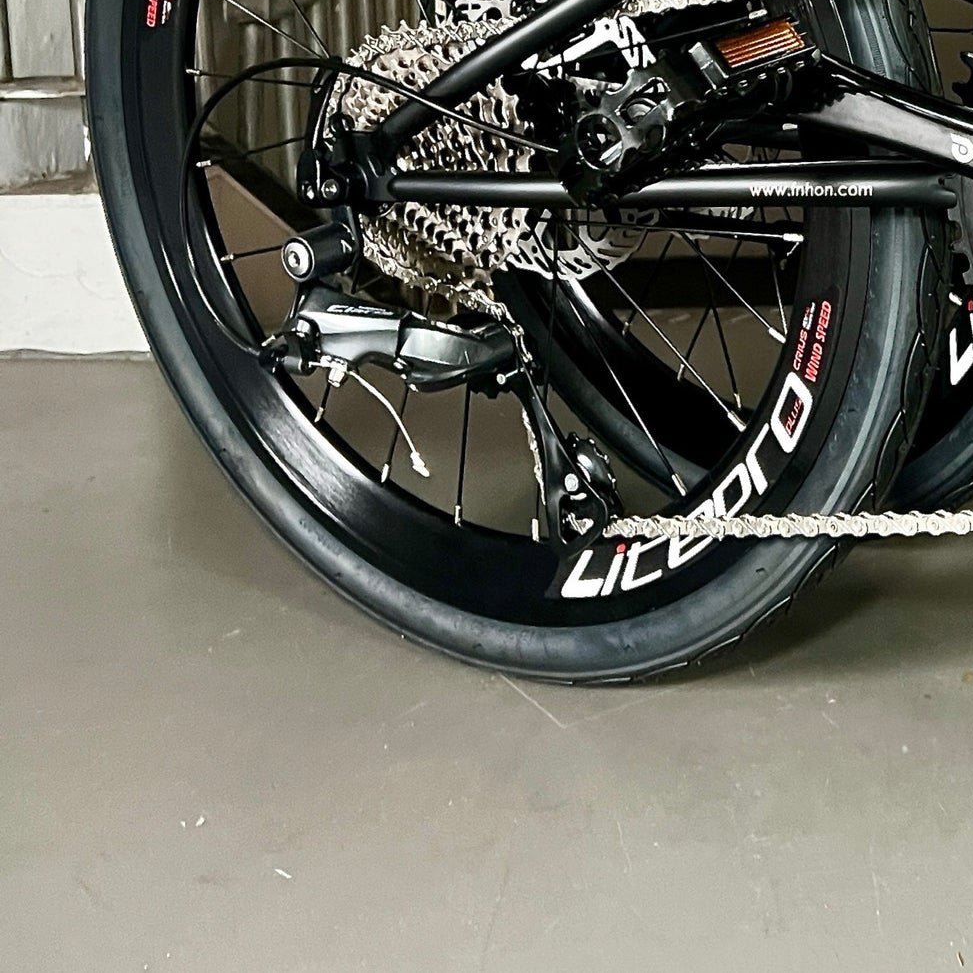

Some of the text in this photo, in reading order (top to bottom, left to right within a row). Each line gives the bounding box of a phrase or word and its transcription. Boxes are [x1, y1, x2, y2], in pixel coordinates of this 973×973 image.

[749, 181, 873, 197] www.fnhon.com
[804, 342, 823, 382] WIND
[815, 300, 831, 342] SPEED
